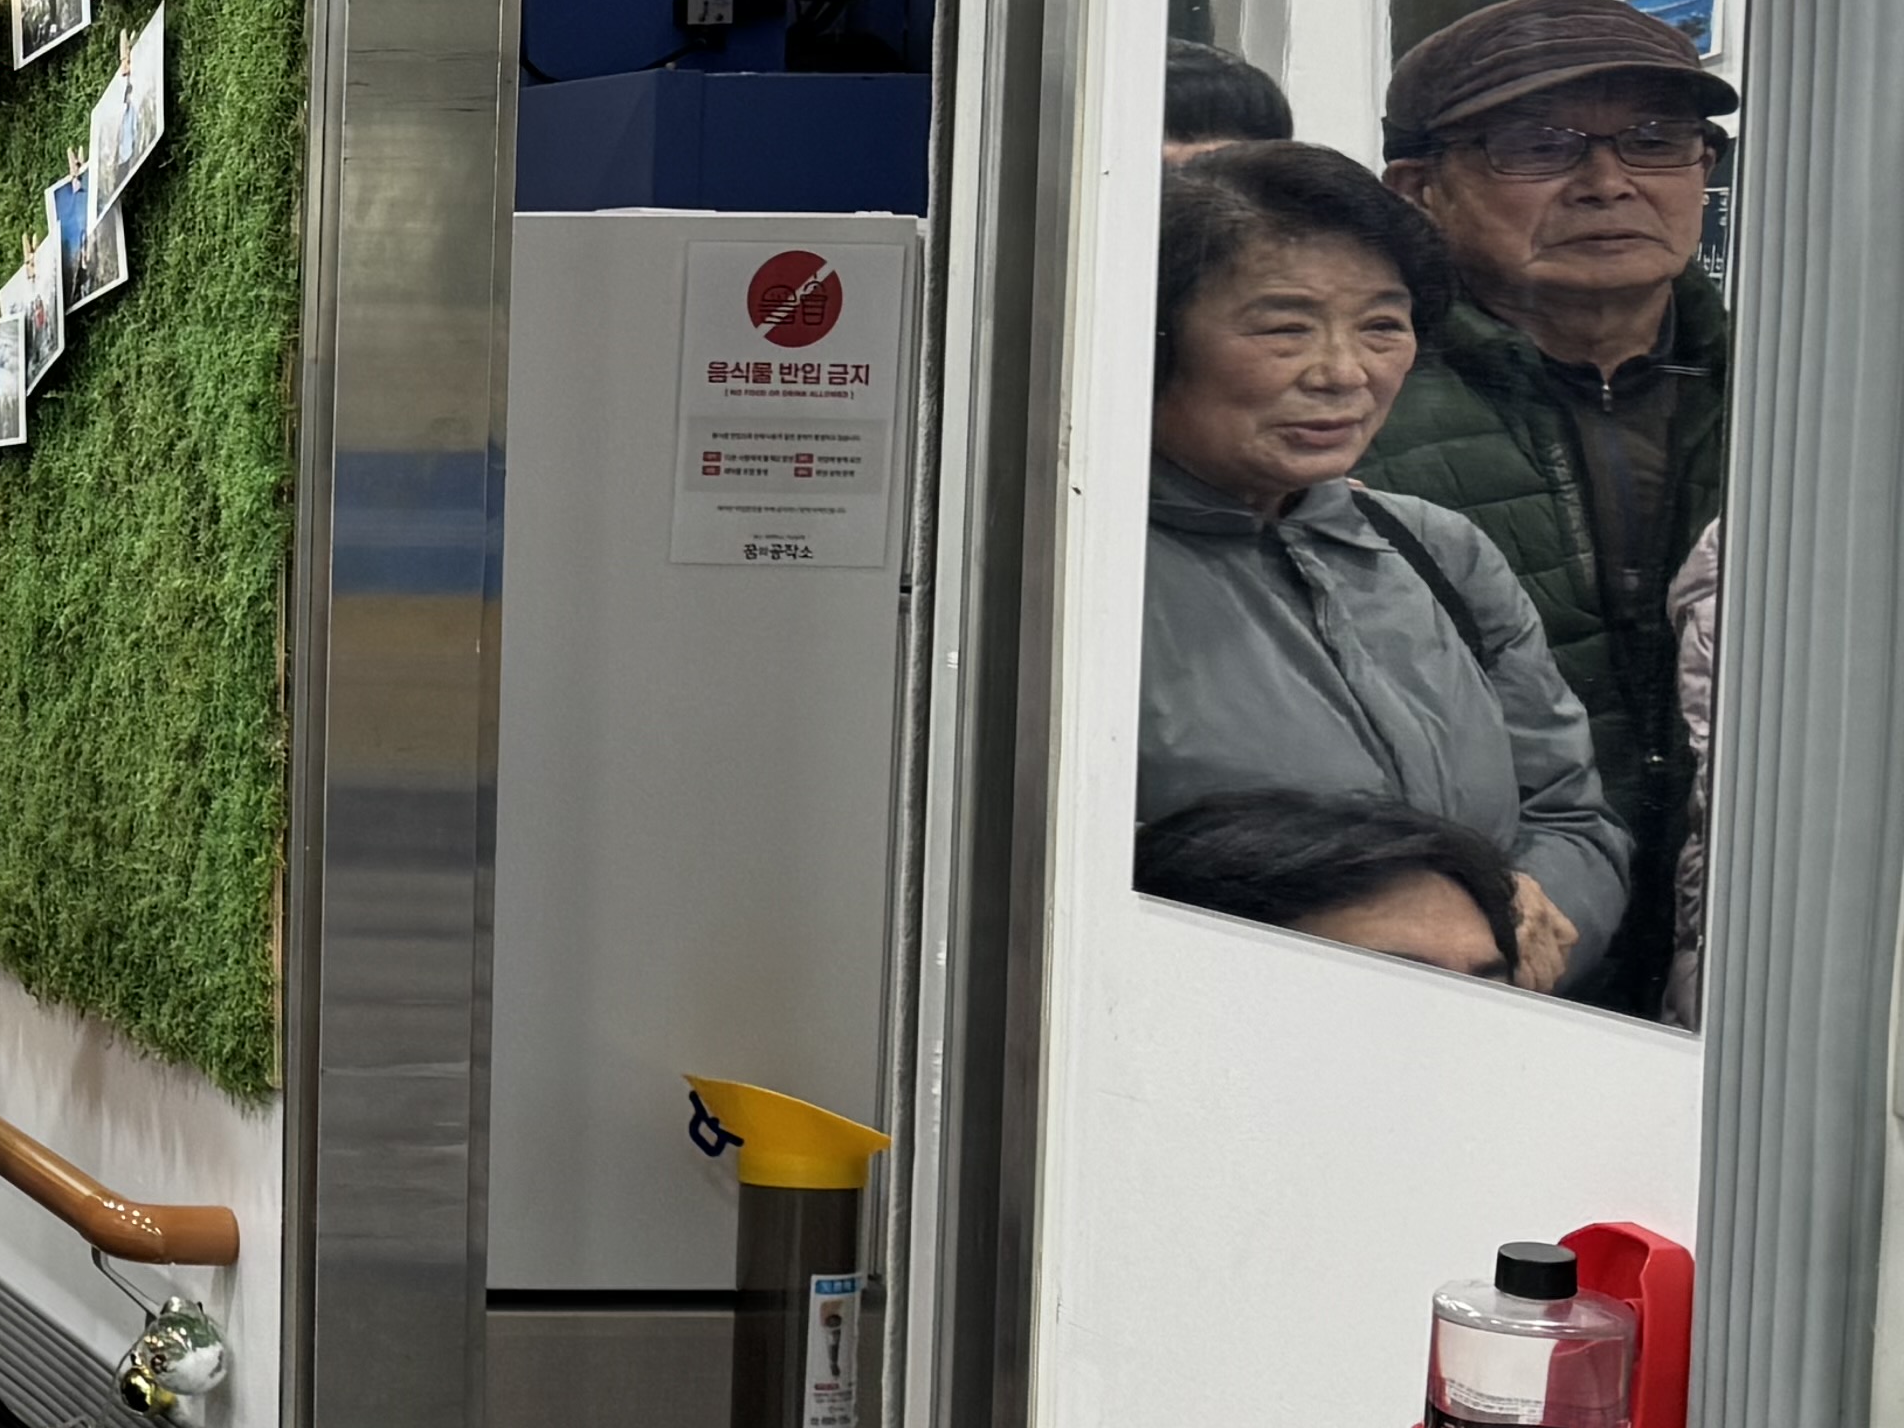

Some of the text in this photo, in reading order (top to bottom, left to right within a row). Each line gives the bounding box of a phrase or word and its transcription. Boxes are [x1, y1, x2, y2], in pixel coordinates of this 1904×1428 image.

[707, 361, 870, 386] 음식물 반입 금지
